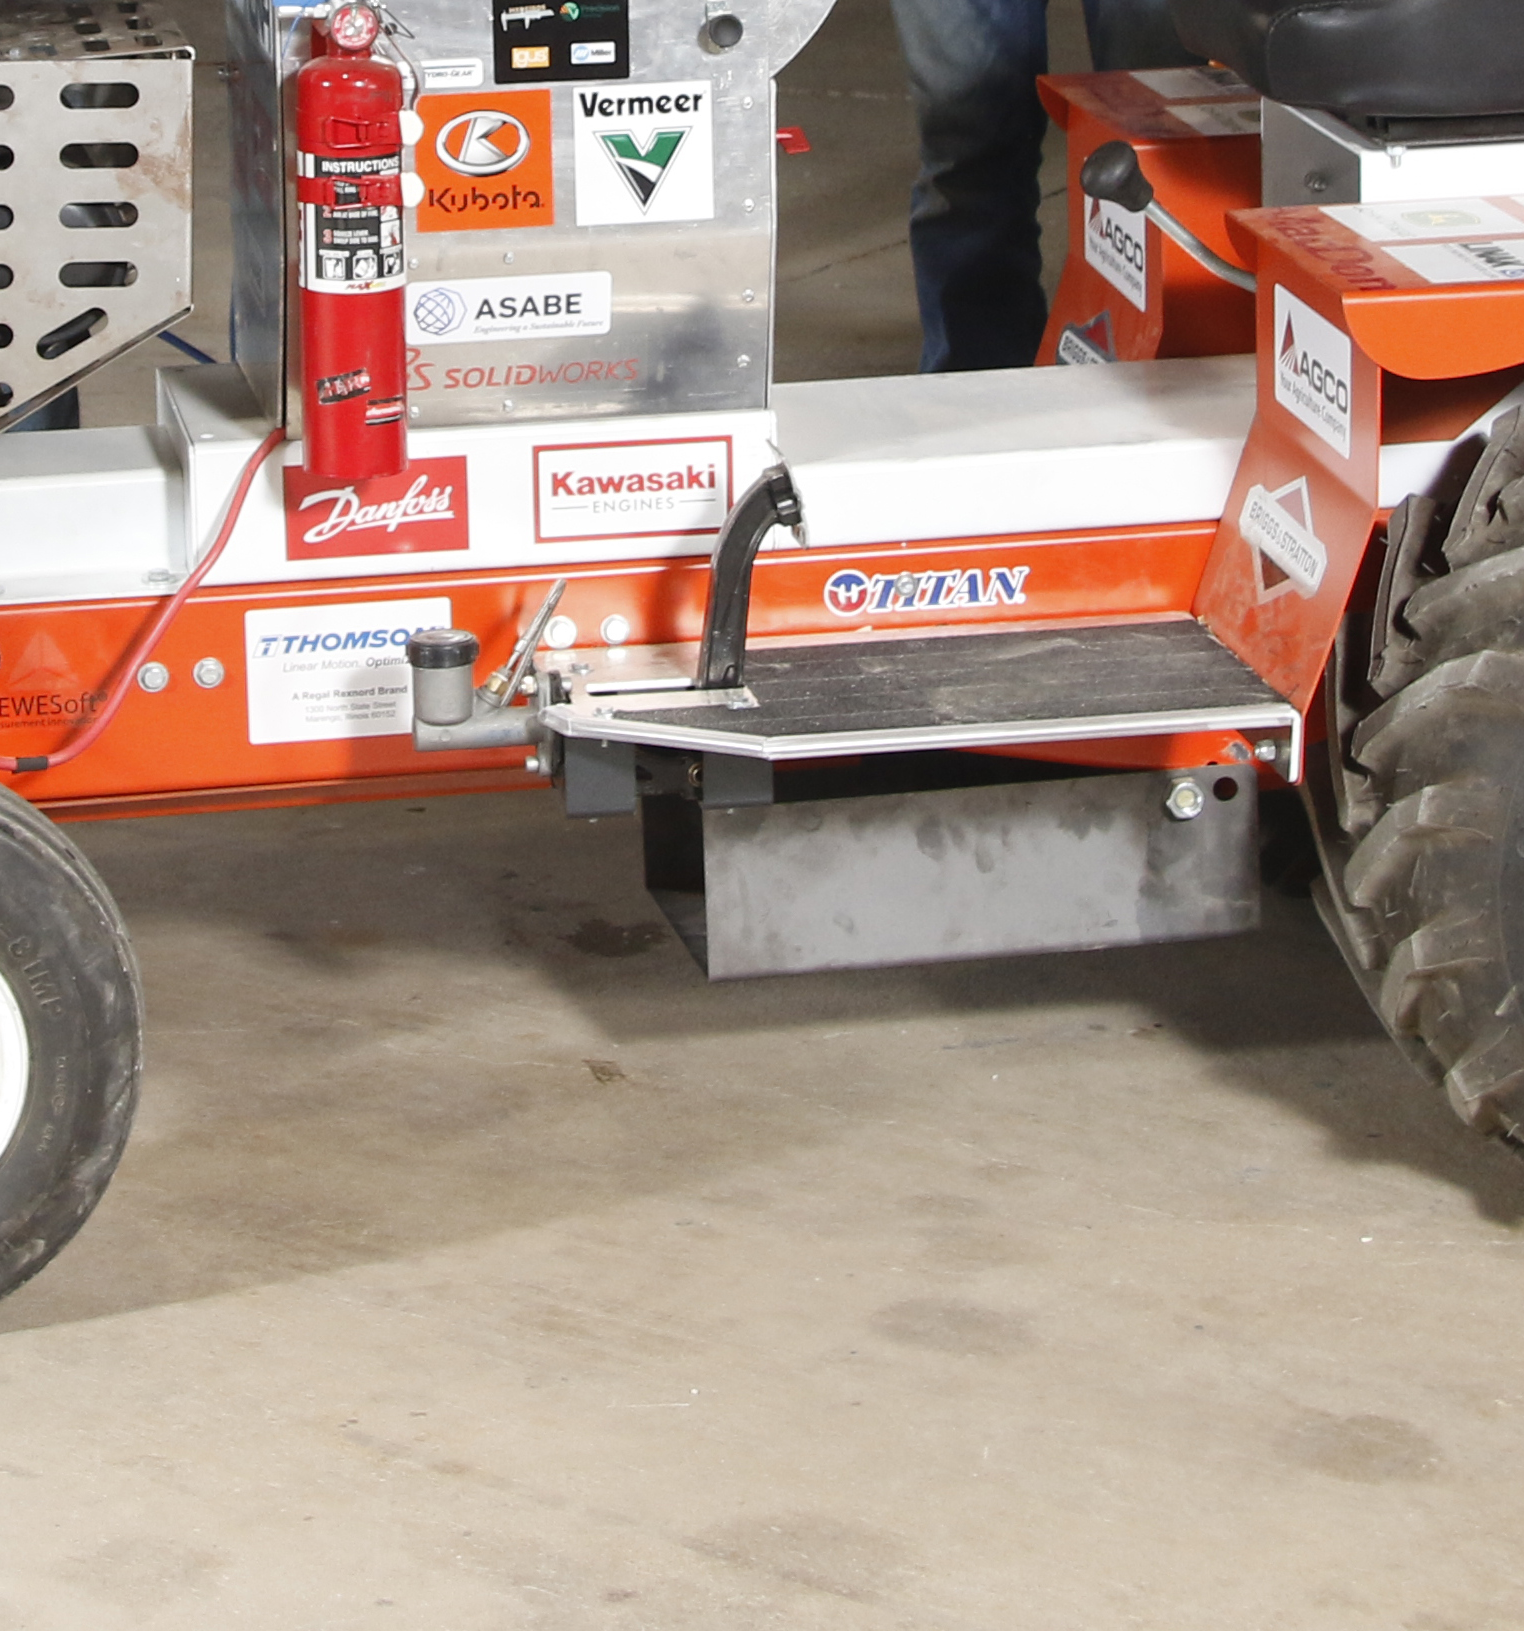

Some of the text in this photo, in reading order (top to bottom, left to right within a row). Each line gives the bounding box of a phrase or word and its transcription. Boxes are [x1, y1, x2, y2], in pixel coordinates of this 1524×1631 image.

[579, 92, 702, 118] Vermeer
[321, 156, 400, 173] INSTRUCTIONS
[429, 184, 541, 213] Kubota
[1105, 216, 1143, 273] AGCO
[475, 293, 582, 319] ASABE
[473, 323, 521, 335] Engineering
[530, 319, 574, 331] Sustainable
[576, 319, 603, 328] Future
[443, 358, 640, 389] SOLIDWORKS
[1299, 351, 1348, 415] AGCO
[1280, 370, 1347, 443] Your Agriculture Company
[551, 464, 716, 497] Kawasaki
[298, 474, 454, 543] Danfoss
[592, 497, 675, 514] ENGINES
[869, 567, 1027, 613] TITAN
[283, 659, 318, 673] Linear
[292, 685, 408, 702] A Regal Rexnord Brand
[372, 701, 396, 709] Street
